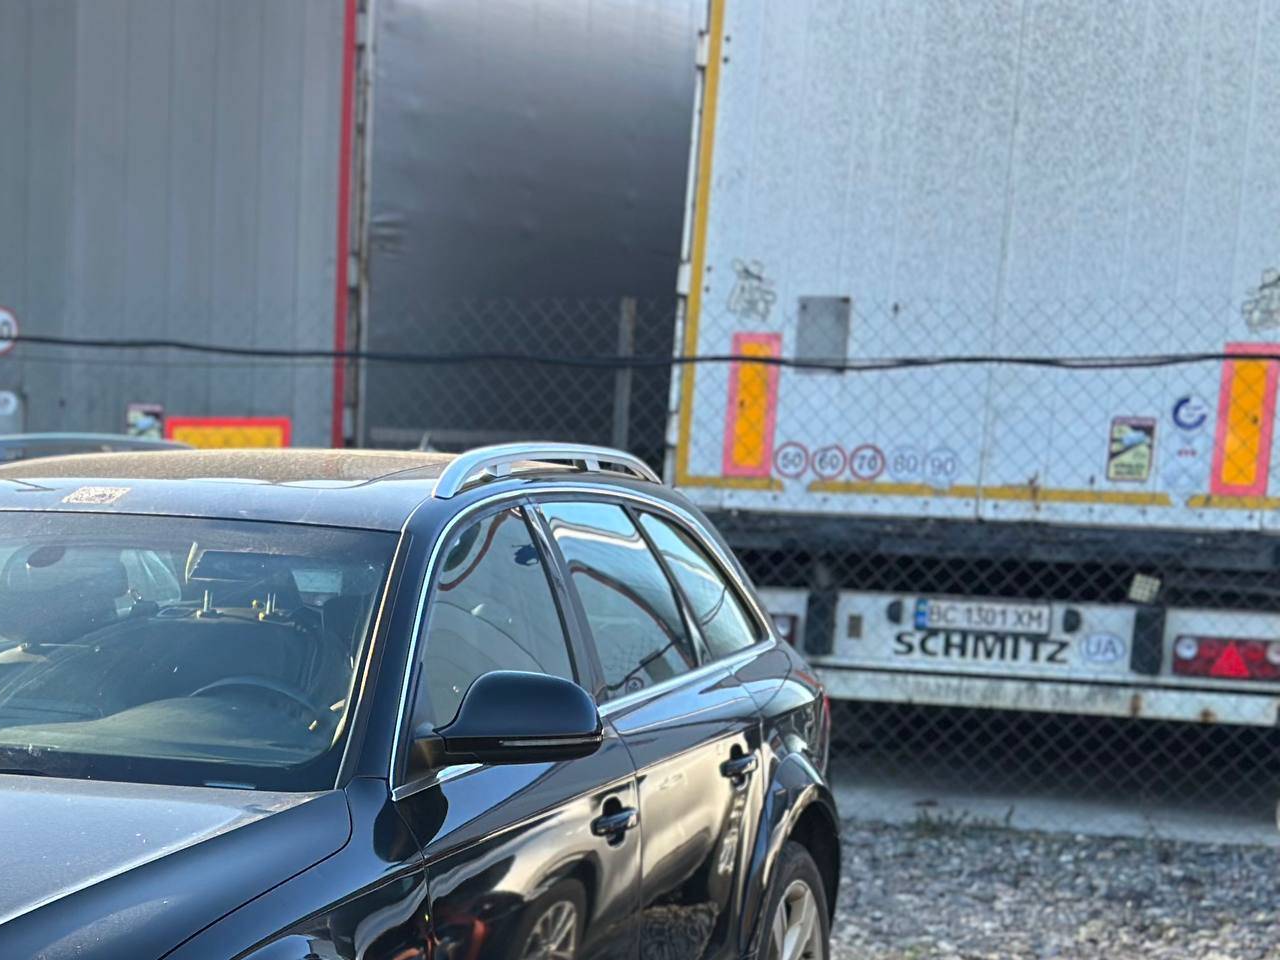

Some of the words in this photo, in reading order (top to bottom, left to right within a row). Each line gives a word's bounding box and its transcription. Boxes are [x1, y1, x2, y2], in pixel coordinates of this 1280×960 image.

[781, 452, 804, 468] 50
[819, 454, 841, 470] 60
[857, 454, 878, 470] 70
[893, 454, 918, 473] 80
[930, 457, 956, 476] 90
[929, 606, 958, 624] BC
[894, 630, 1069, 664] SCHMITZ
[1085, 638, 1119, 657] UA
